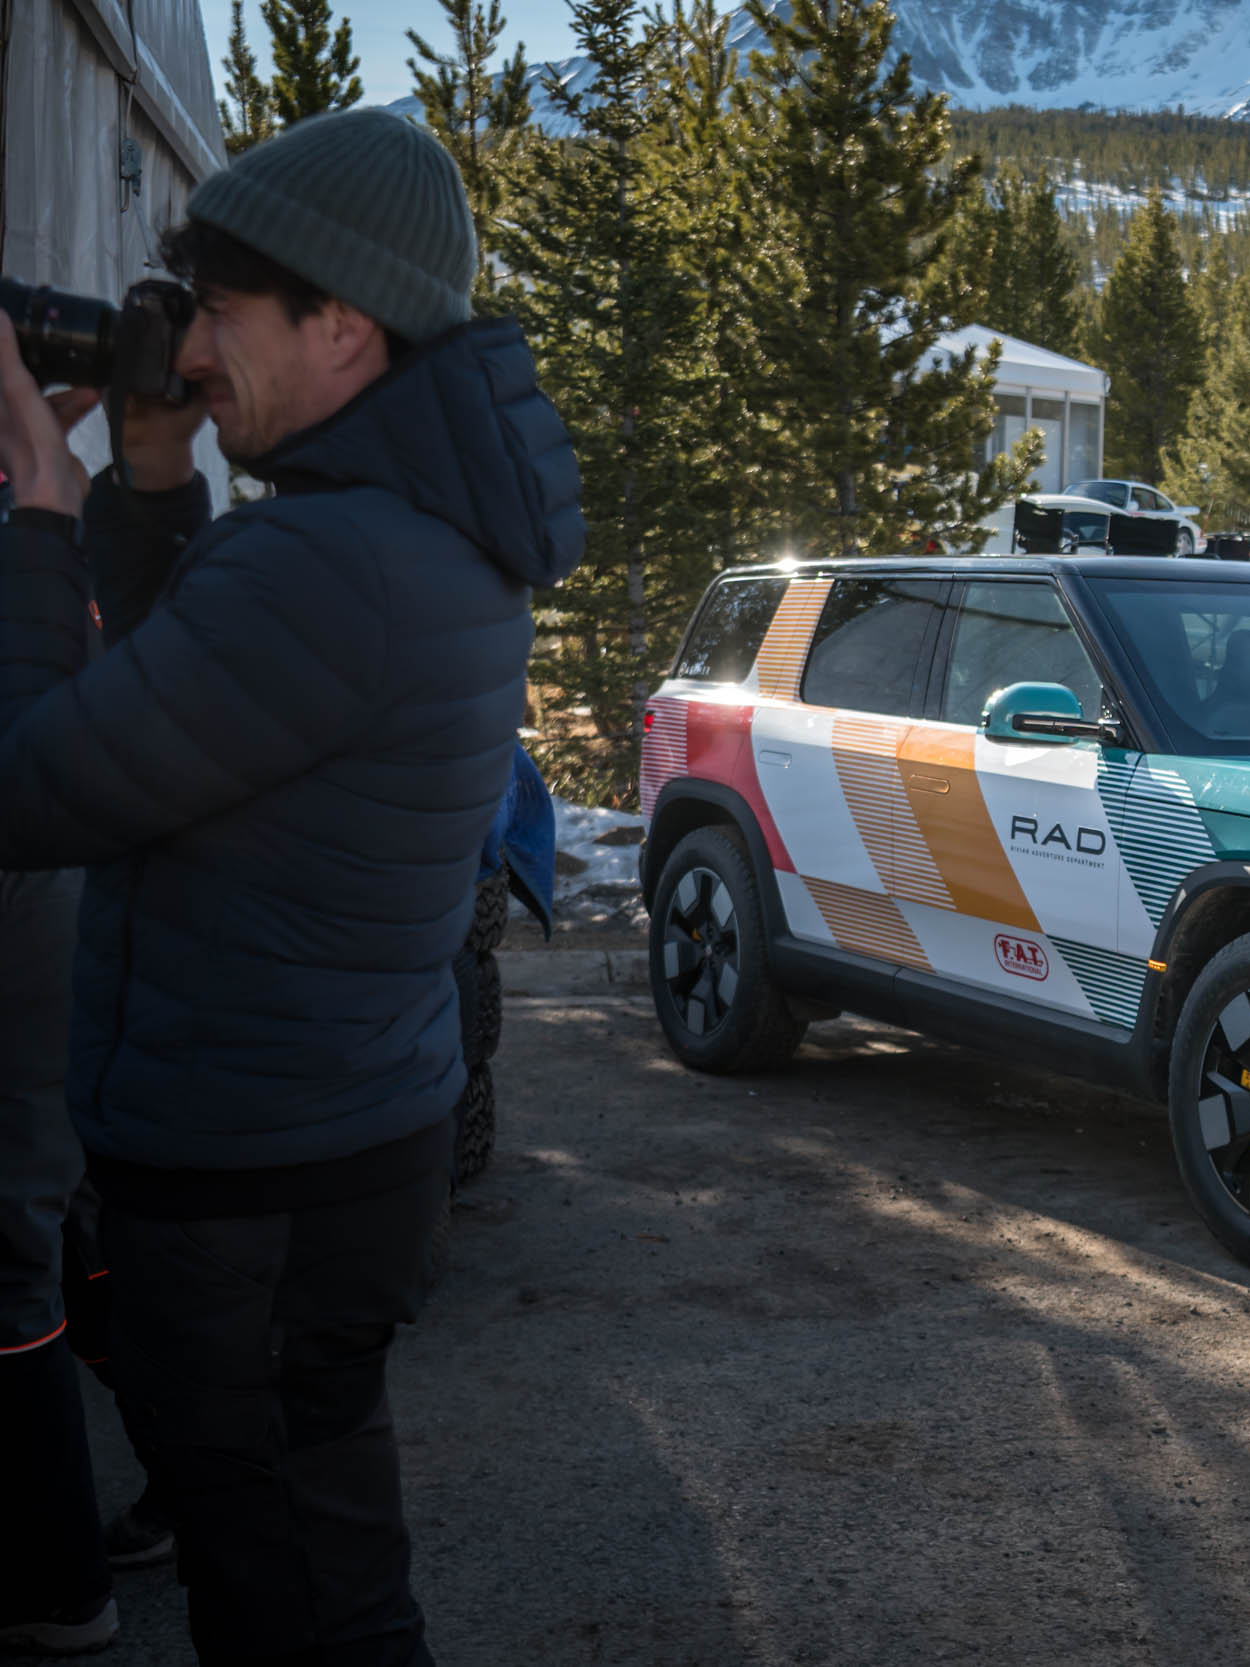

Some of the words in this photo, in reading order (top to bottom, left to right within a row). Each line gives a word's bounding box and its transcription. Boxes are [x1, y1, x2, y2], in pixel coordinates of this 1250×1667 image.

[1011, 815, 1106, 855] RAD
[1031, 850, 1064, 862] ADVENTURE
[1066, 855, 1105, 869] DEPARTMENT
